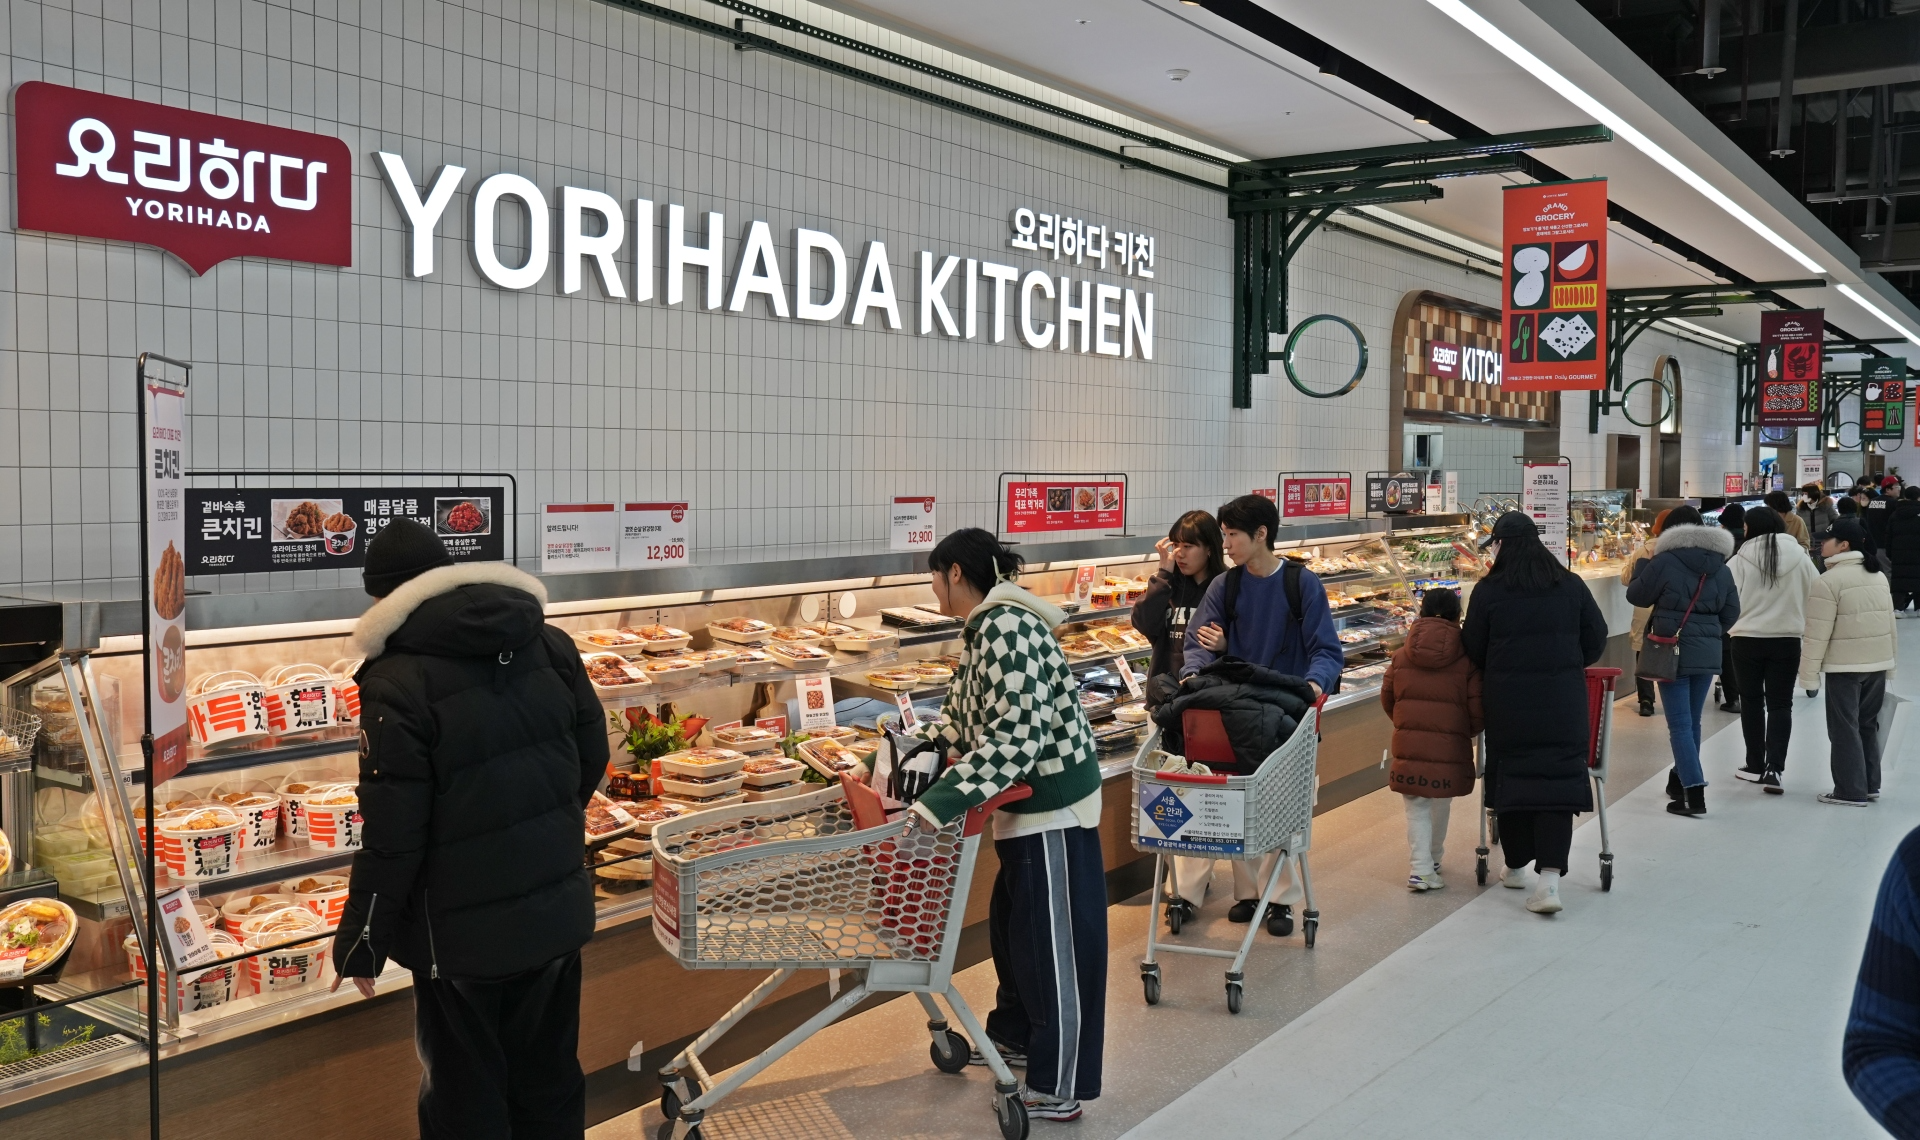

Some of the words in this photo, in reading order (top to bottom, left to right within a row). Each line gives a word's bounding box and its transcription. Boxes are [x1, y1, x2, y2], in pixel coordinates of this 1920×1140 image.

[56, 117, 328, 212] 요리하다
[125, 196, 271, 234] YORIHADA
[1543, 203, 1568, 212] GRAND
[1535, 213, 1575, 222] GROCERY
[1010, 207, 1109, 268] 요리하다
[1112, 232, 1154, 278] 키친
[371, 151, 902, 330] YORIHADA
[916, 250, 1154, 360] KITCHEN
[1432, 346, 1458, 366] 요리하다
[154, 448, 180, 480] 큰치킨
[1014, 487, 1038, 499] 우리가족
[201, 501, 246, 514] 겉바속촉
[363, 499, 419, 515] 매콤달콤
[1014, 500, 1027, 510] 대표
[1027, 499, 1045, 510] 먹거리
[201, 517, 262, 540] 큰치킨
[546, 524, 579, 533] 알려드립니다!
[908, 530, 933, 545] 12,900
[272, 545, 304, 553] 후라이드의
[304, 544, 318, 552] 정석
[647, 544, 684, 562] 12,900
[201, 555, 235, 564] 요리하다
[186, 693, 247, 746] 가득
[1390, 771, 1451, 789] Reebok
[1161, 796, 1175, 806] 서울
[1153, 805, 1166, 821] 온
[1166, 807, 1183, 817] 안과
[1163, 840, 1178, 848] 불광역
